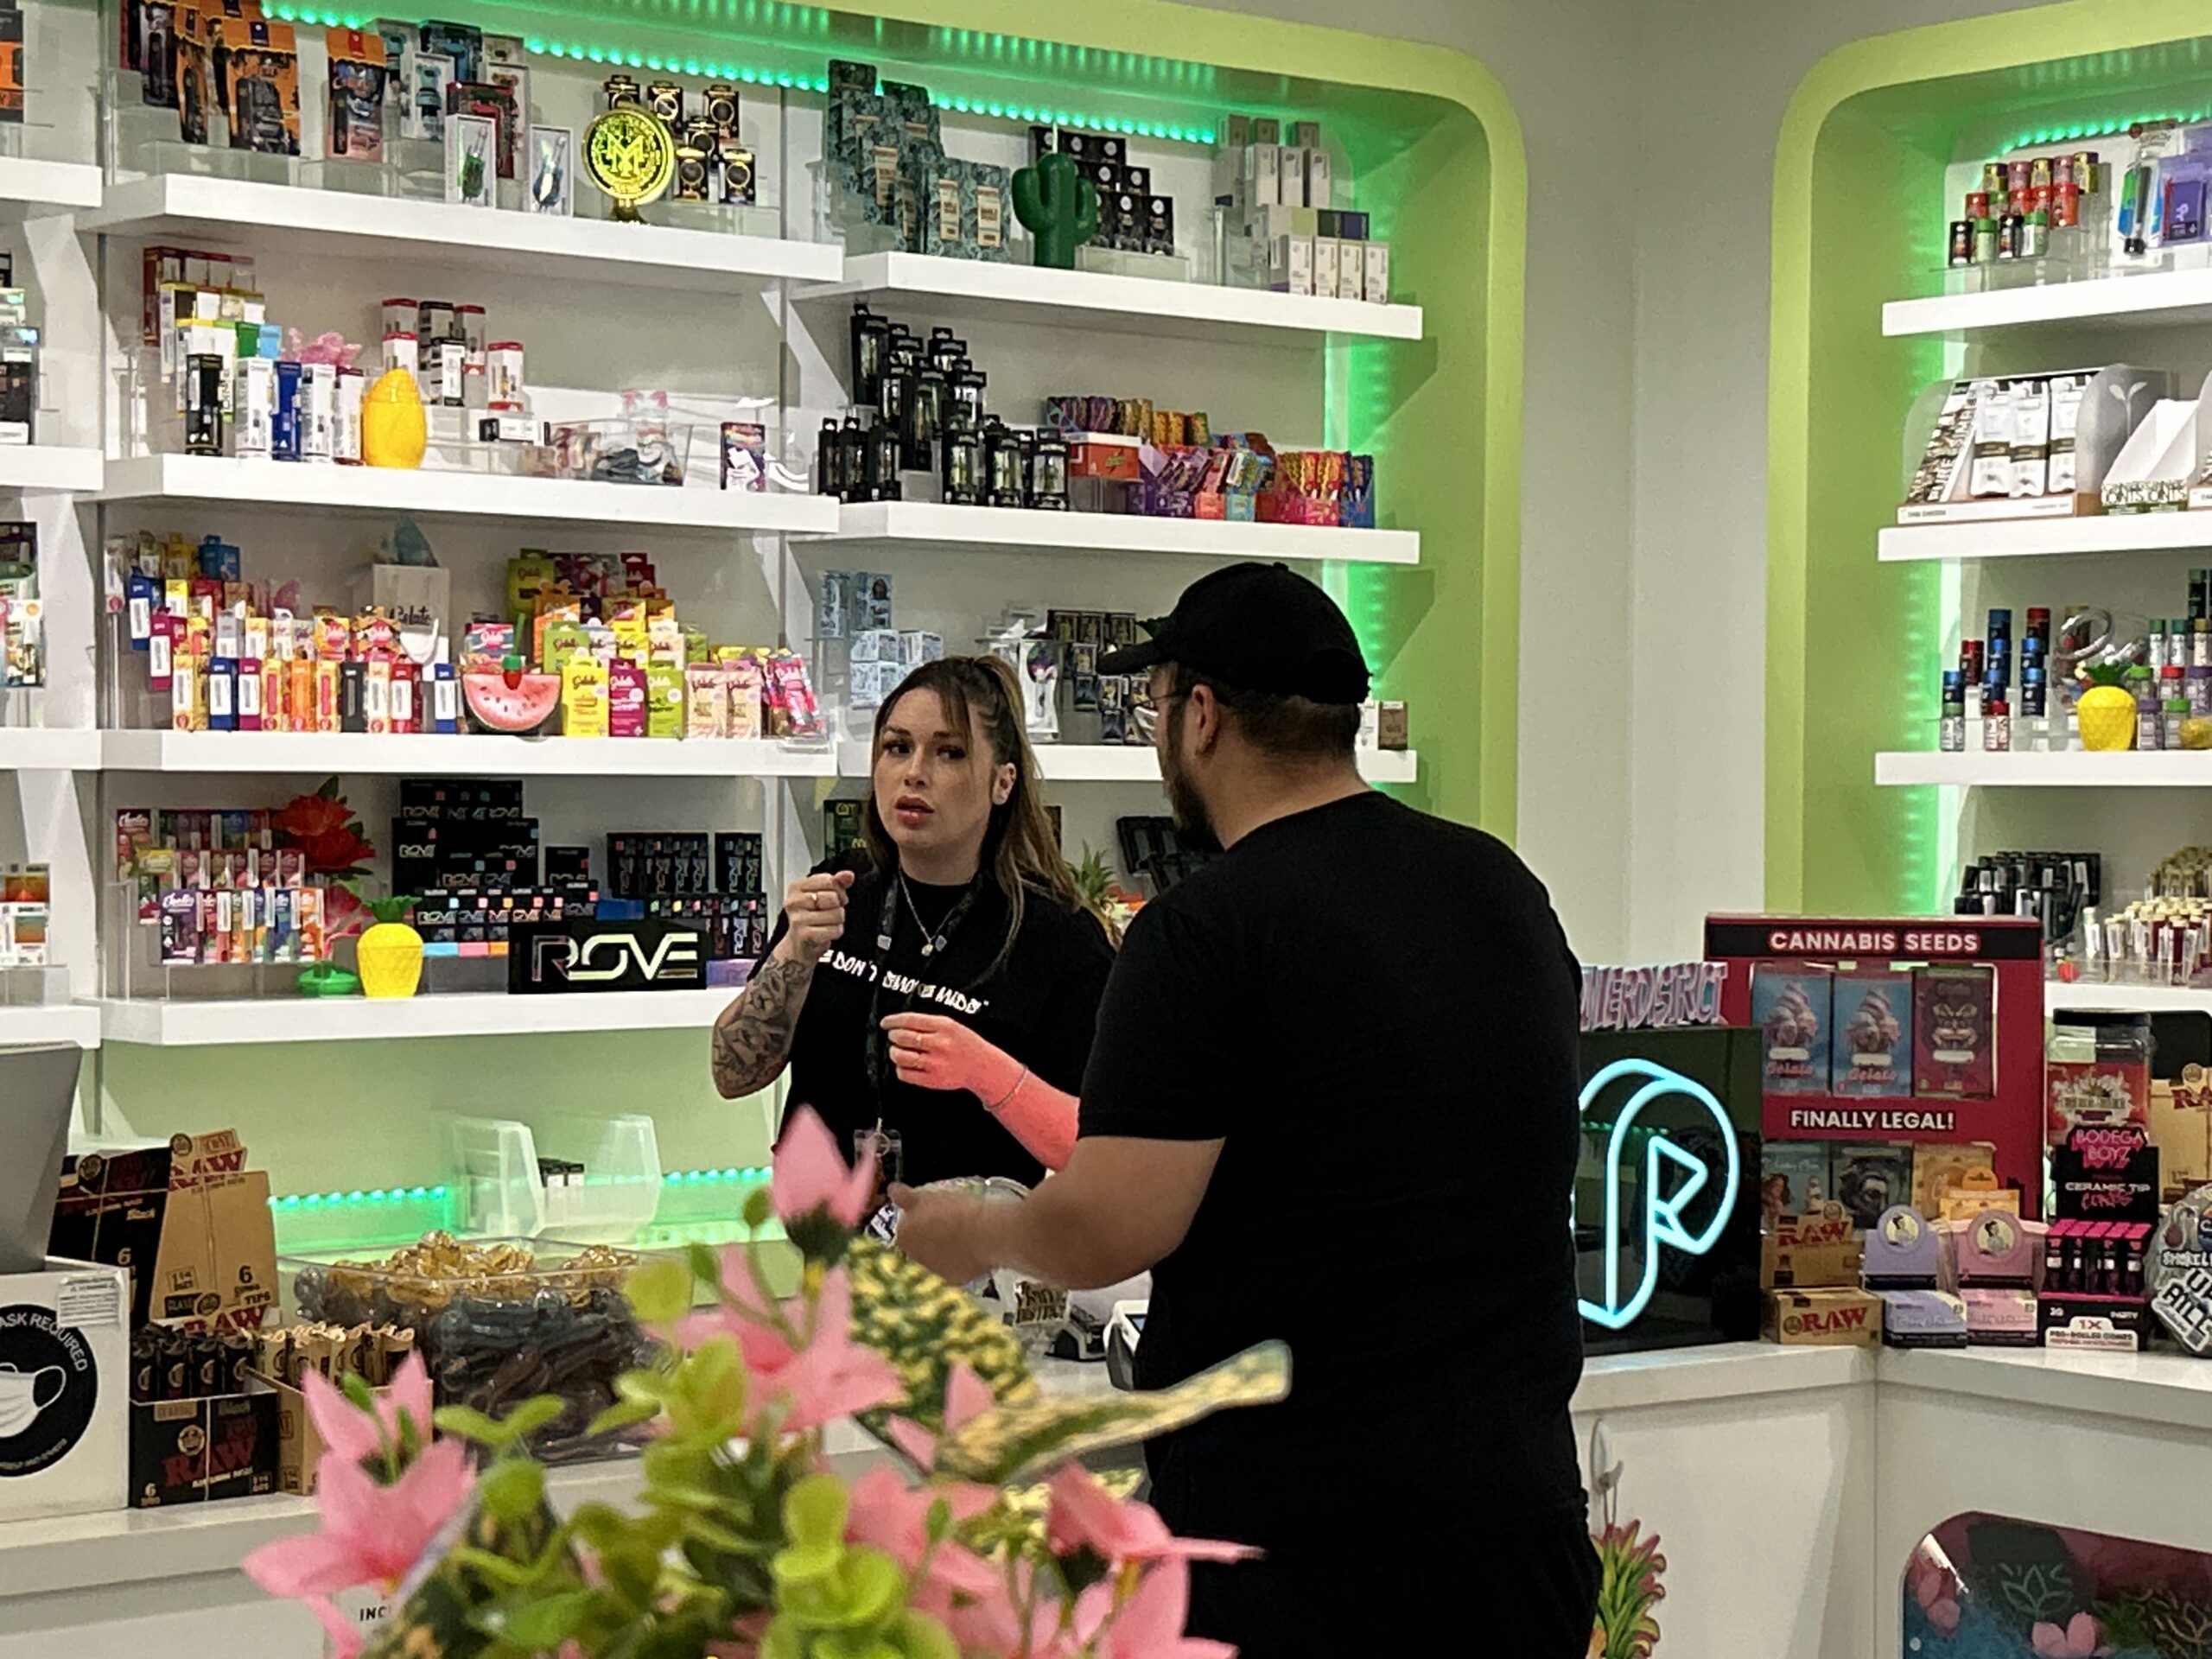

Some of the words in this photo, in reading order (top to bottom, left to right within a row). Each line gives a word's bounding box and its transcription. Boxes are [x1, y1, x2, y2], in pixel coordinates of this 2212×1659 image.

[1770, 932, 1896, 950] CANNABIS
[1904, 933, 1978, 951] SEEDS
[531, 932, 698, 982] ROVE
[1791, 1109, 1878, 1129] FINALLY
[1881, 1111, 1955, 1130] LEGAL!
[2075, 1128, 2145, 1145] BODEGA
[2088, 1145, 2132, 1162] BOYZ
[2064, 1182, 2126, 1192] CERAMIC
[2127, 1183, 2152, 1193] TIP
[118, 1248, 131, 1266] 6
[238, 1265, 253, 1284] 6
[1800, 1306, 1868, 1332] RAW
[0, 1313, 29, 1328] ASK
[29, 1312, 89, 1372] REQUIRED
[162, 1437, 256, 1488] RAW
[144, 1482, 156, 1497] 6
